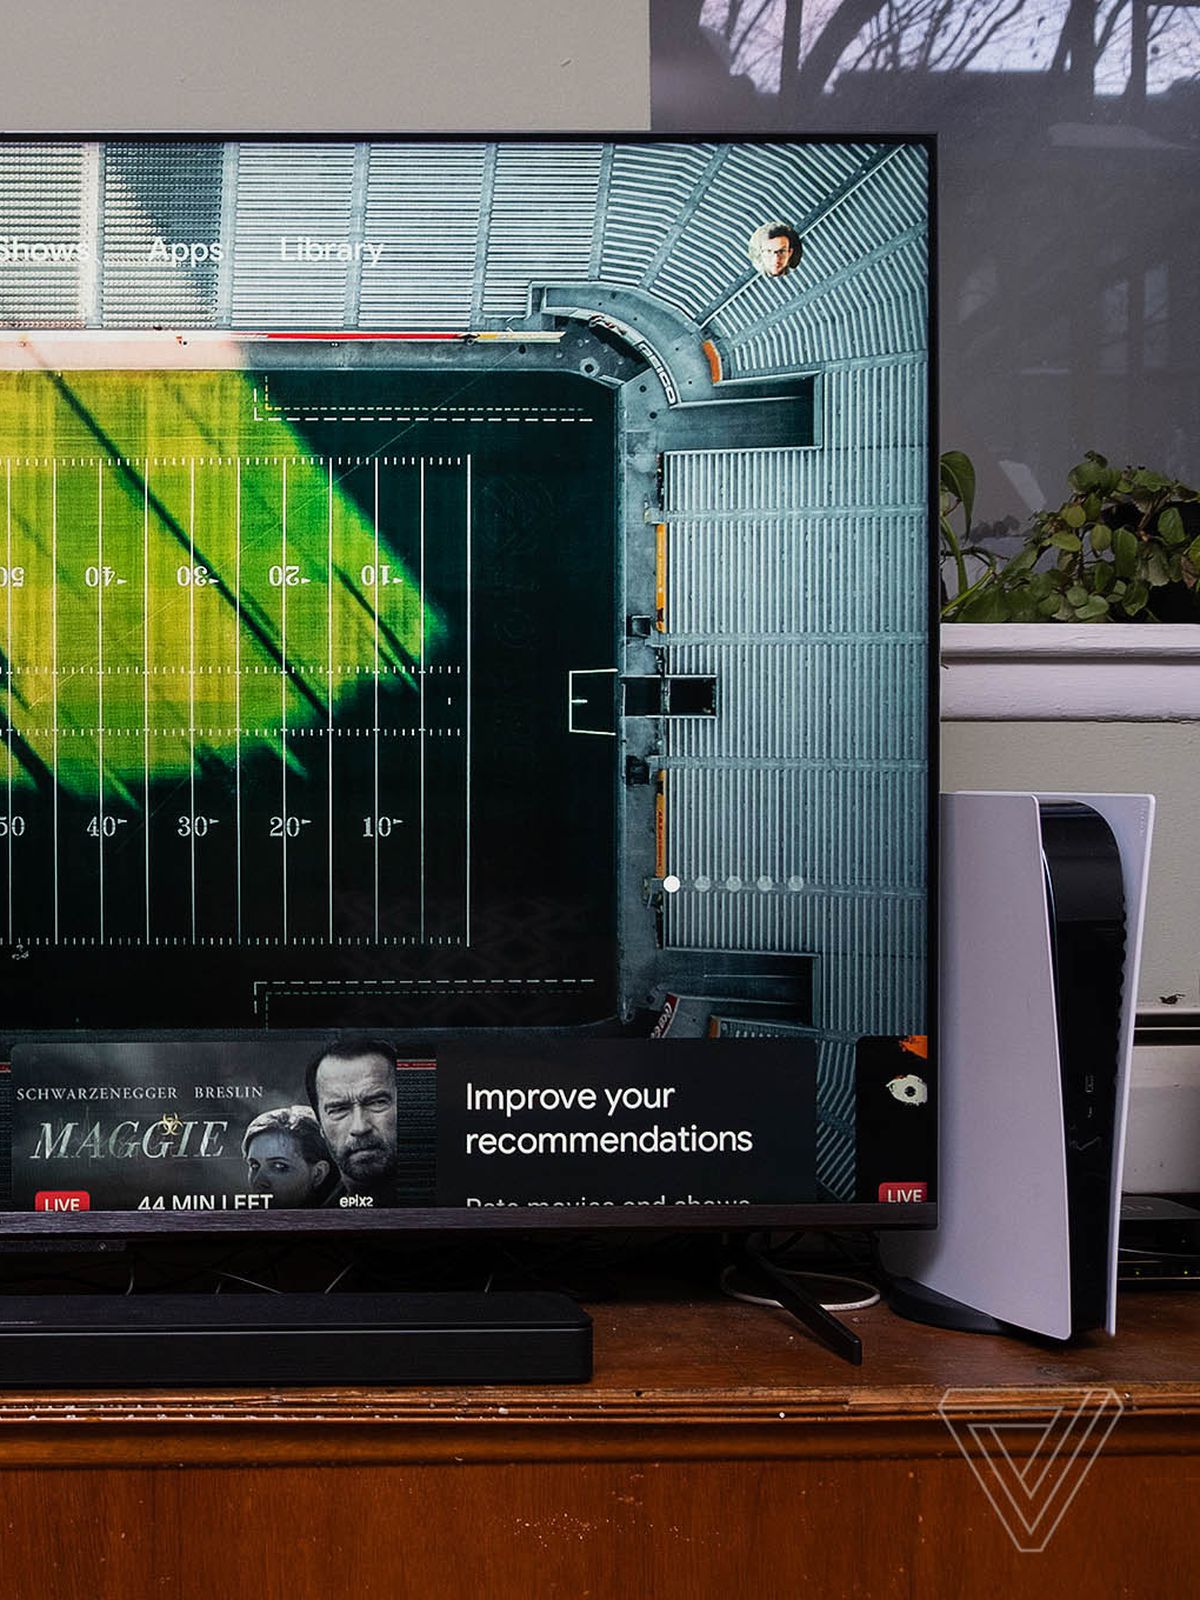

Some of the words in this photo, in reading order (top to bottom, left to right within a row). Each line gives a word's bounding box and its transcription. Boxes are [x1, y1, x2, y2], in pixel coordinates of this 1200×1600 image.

[148, 236, 224, 267] Apps
[280, 236, 384, 268] Library
[85, 565, 116, 587] 40
[177, 565, 210, 587] 30
[269, 564, 301, 586] 20
[361, 564, 392, 586] 10
[86, 816, 117, 837] 40
[177, 816, 209, 837] 30
[269, 816, 301, 837] 20
[362, 816, 392, 837] 10
[17, 1086, 178, 1101] SCHWARZENEGGER
[194, 1085, 263, 1099] BRESLIN
[465, 1082, 597, 1117] Improve
[604, 1086, 675, 1117] your
[29, 1119, 230, 1159] MAGGIE
[465, 1124, 753, 1154] recommendations
[45, 1198, 80, 1212] LIVE
[172, 1194, 215, 1210] MIN
[339, 1193, 374, 1207] epix2
[887, 1189, 922, 1203] LIVE
